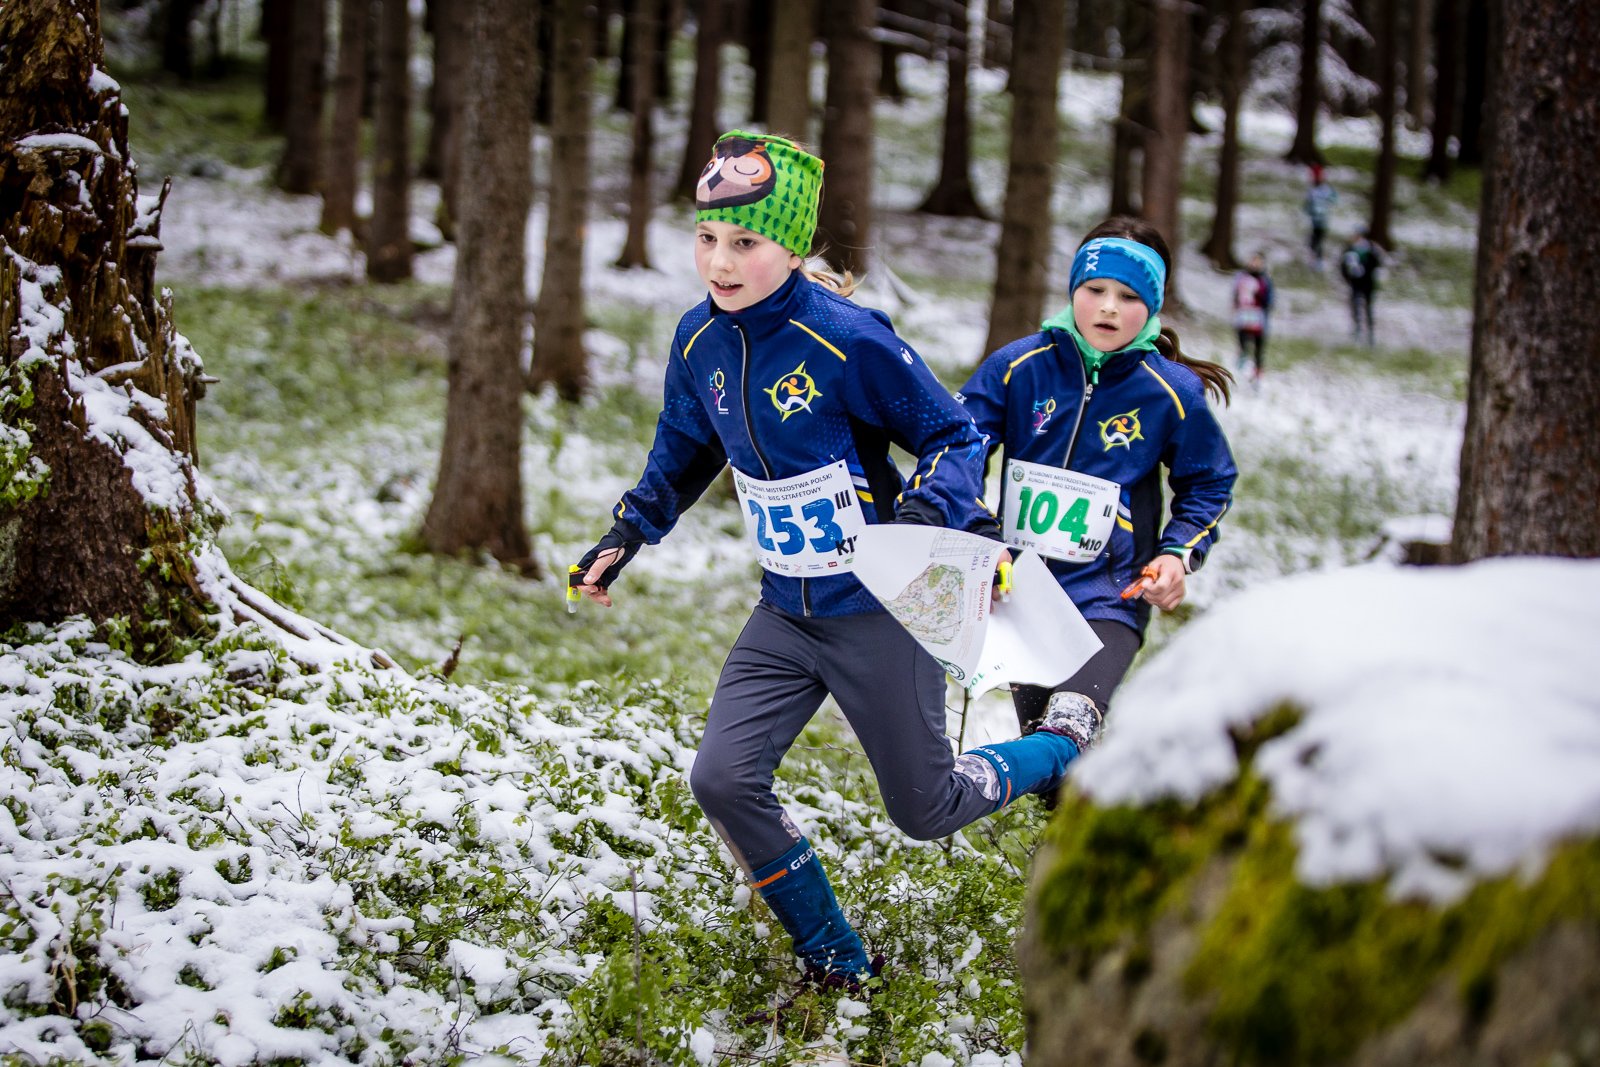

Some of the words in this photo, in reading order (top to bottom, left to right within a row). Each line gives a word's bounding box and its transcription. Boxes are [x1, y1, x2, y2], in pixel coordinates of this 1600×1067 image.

[765, 481, 810, 493] MISTRZOSTWA
[810, 473, 833, 485] POLSKI
[1053, 474, 1091, 487] MISTRZOSTWA
[1091, 483, 1108, 492] POLSKI
[1064, 483, 1097, 496] SZTAFETOWY
[781, 486, 822, 501] SZTAFETOWY
[834, 489, 852, 510] III
[1016, 486, 1090, 543] 104
[1102, 504, 1112, 518] II
[747, 497, 844, 556] 253
[1078, 537, 1102, 552] M10
[977, 580, 988, 621] Borowice
